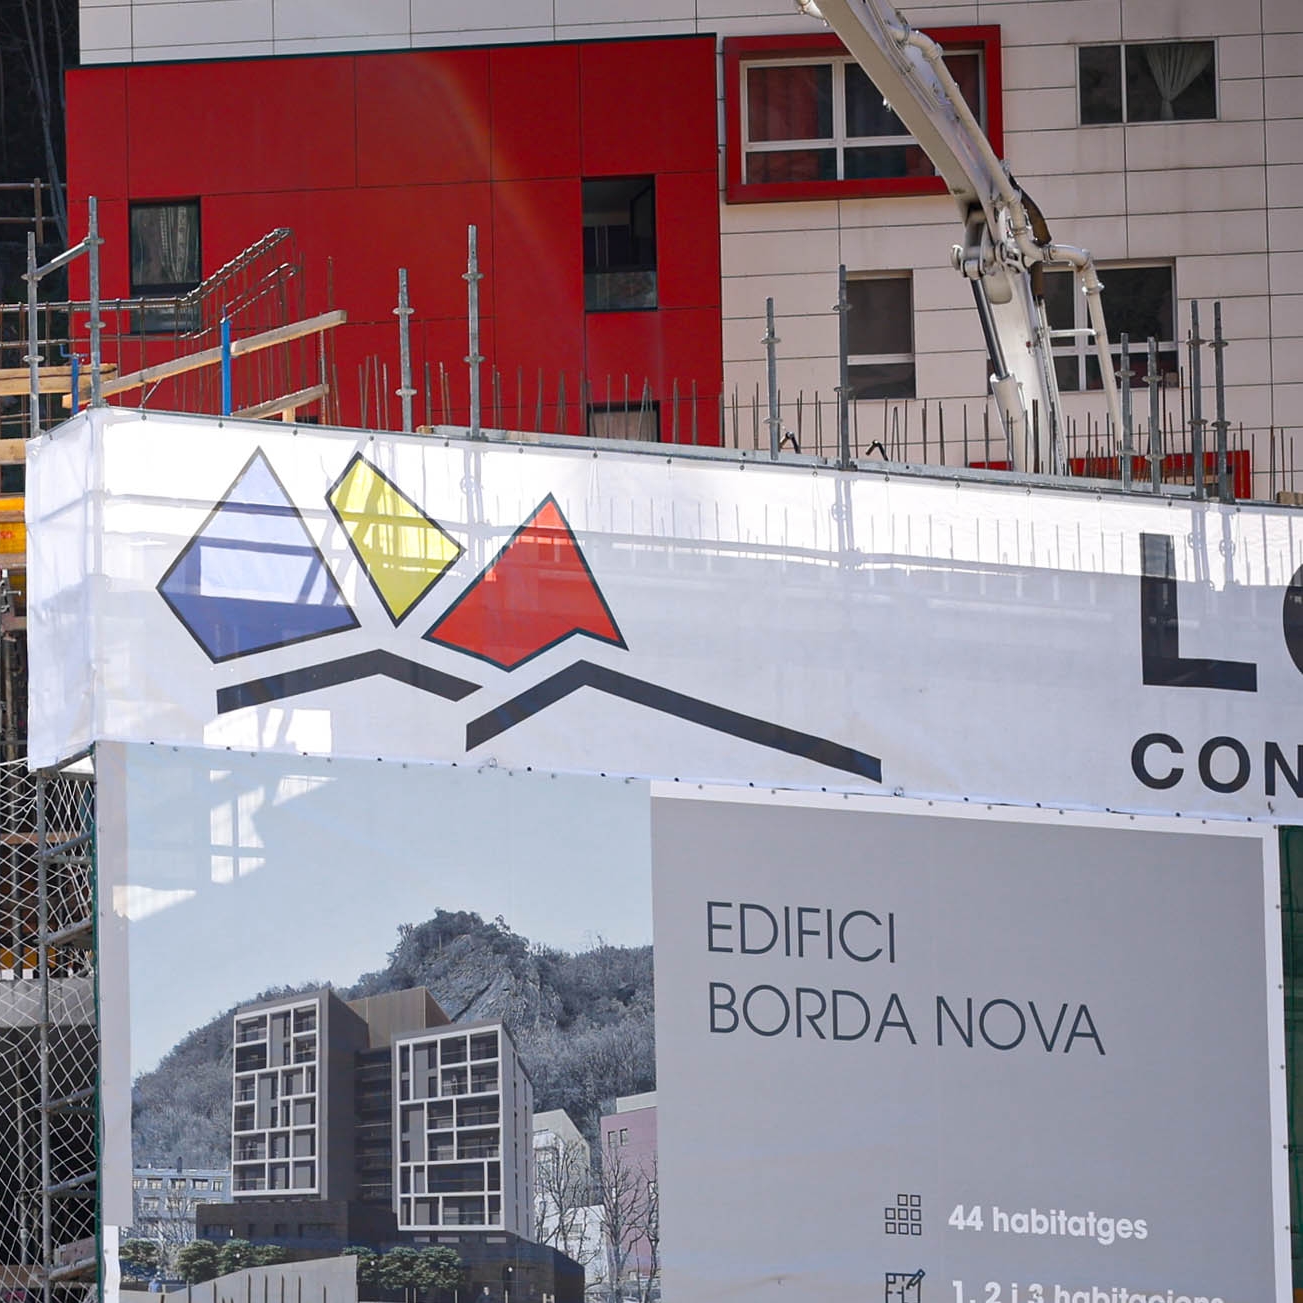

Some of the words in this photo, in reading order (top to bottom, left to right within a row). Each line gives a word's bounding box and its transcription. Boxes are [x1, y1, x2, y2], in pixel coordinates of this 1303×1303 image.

[1140, 533, 1303, 692] L
[707, 901, 895, 963] EDIFICI
[710, 982, 917, 1044] BORDA
[937, 996, 1105, 1055] NOVA
[948, 1205, 984, 1231] 44
[993, 1207, 1149, 1245] habitatges
